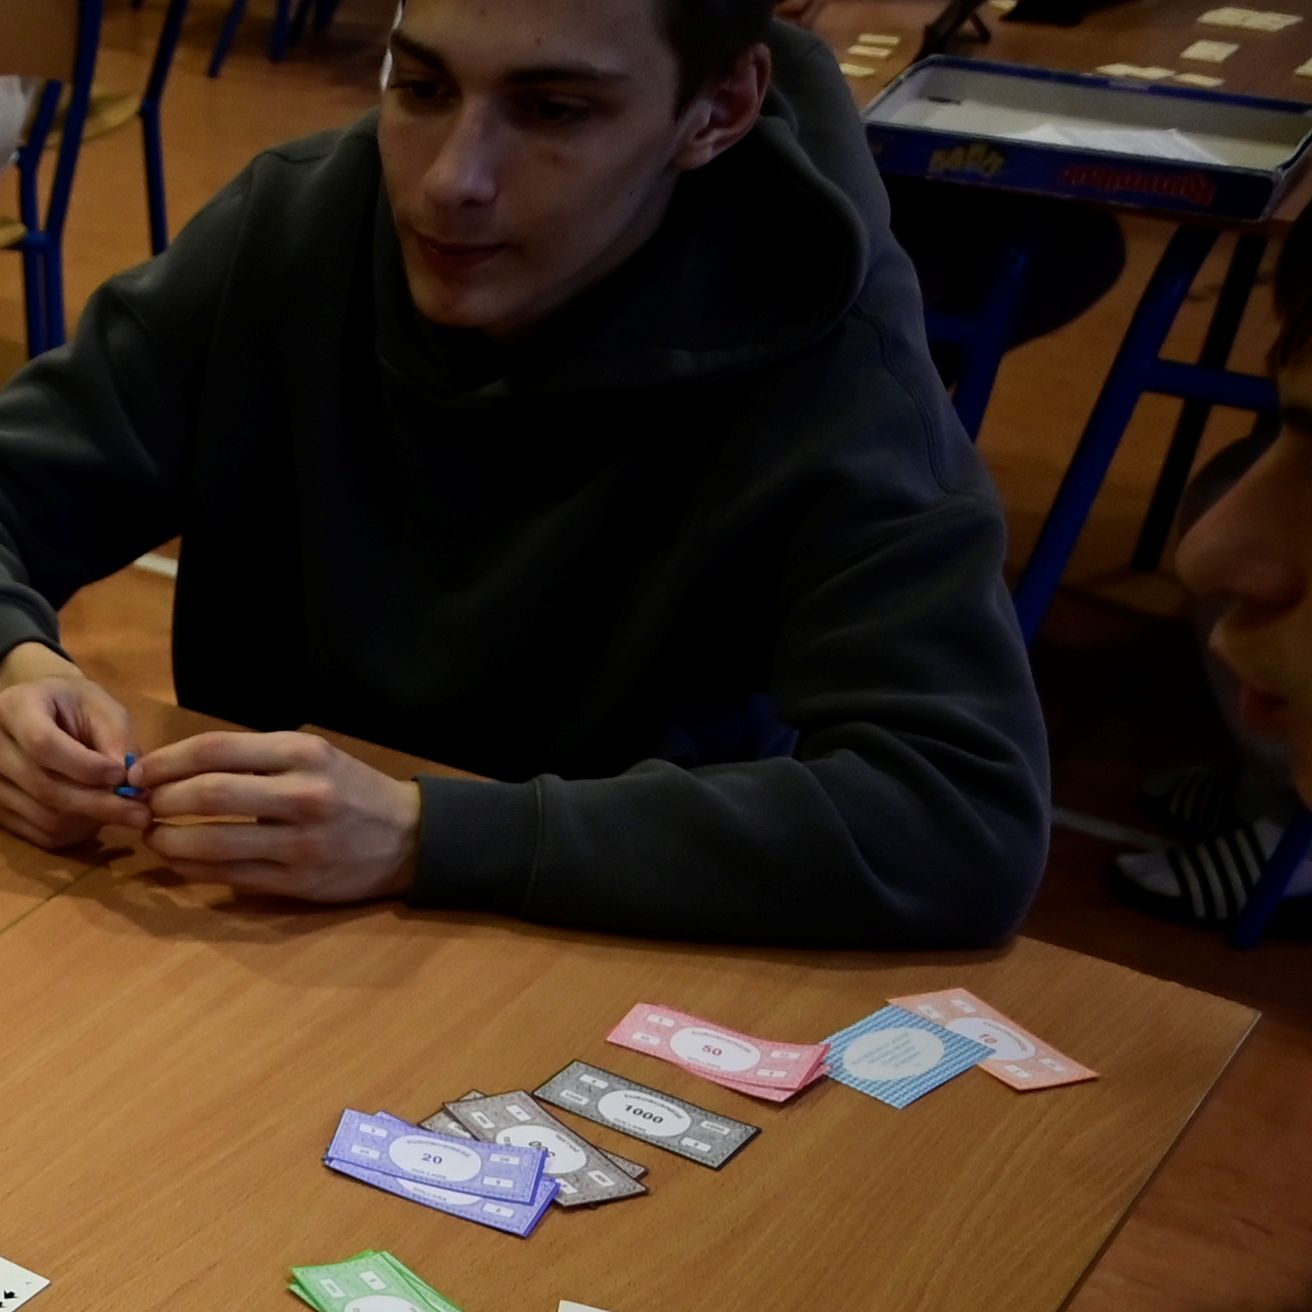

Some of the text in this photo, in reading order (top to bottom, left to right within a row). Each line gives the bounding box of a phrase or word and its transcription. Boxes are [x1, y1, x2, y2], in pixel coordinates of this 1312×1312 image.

[701, 1043, 724, 1058] 50
[623, 1103, 664, 1127] 1000
[421, 1152, 443, 1166] 20
